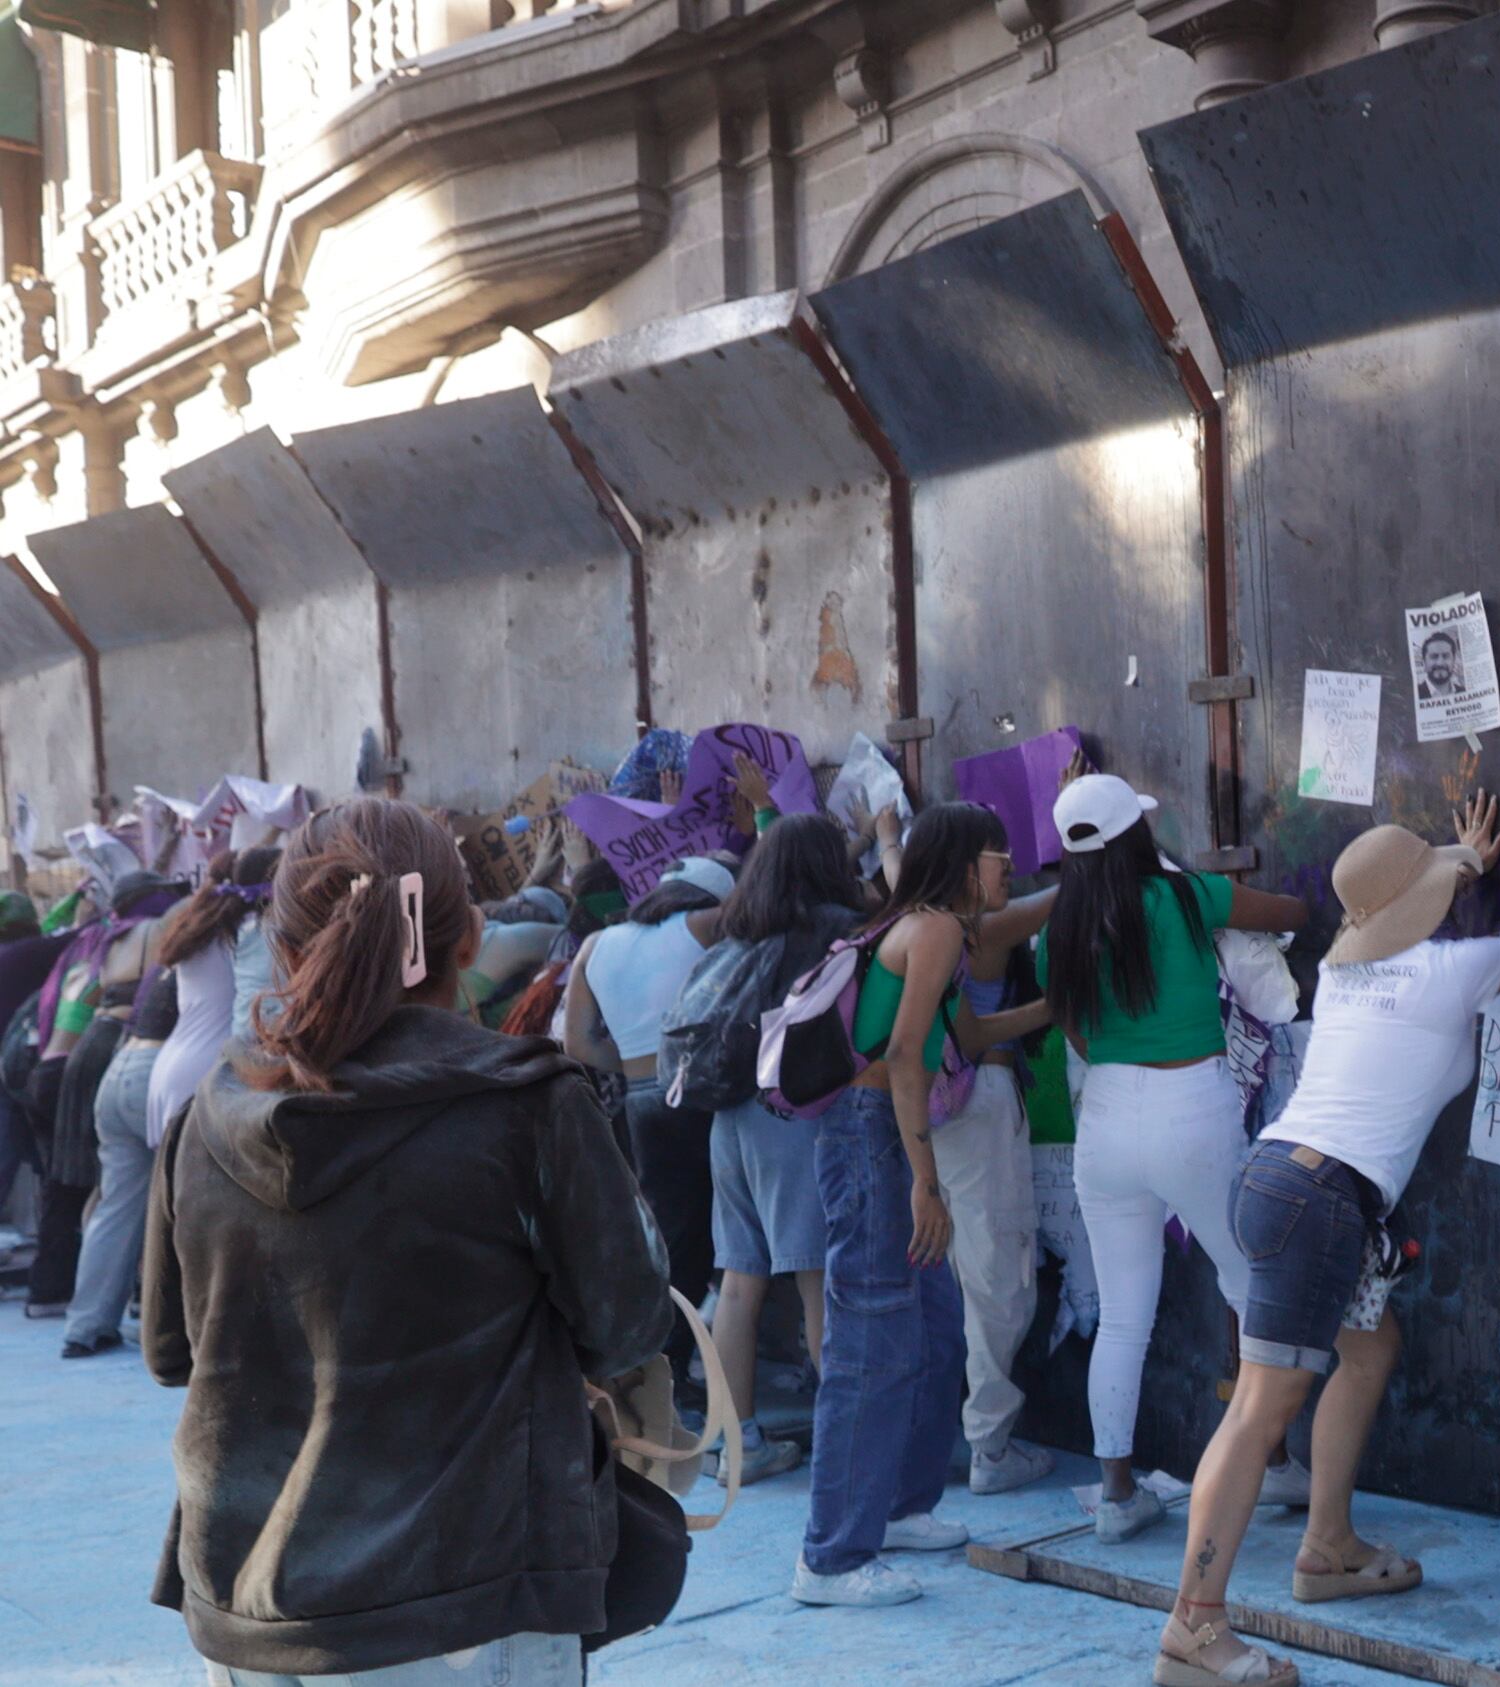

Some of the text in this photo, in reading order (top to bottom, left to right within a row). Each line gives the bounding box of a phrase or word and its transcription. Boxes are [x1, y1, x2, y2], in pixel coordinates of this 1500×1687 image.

[1410, 599, 1483, 627] VIOLADOR
[1419, 699, 1453, 709] RAFAEL
[1446, 703, 1482, 716] REYNOSO
[607, 822, 669, 867] HIJAS
